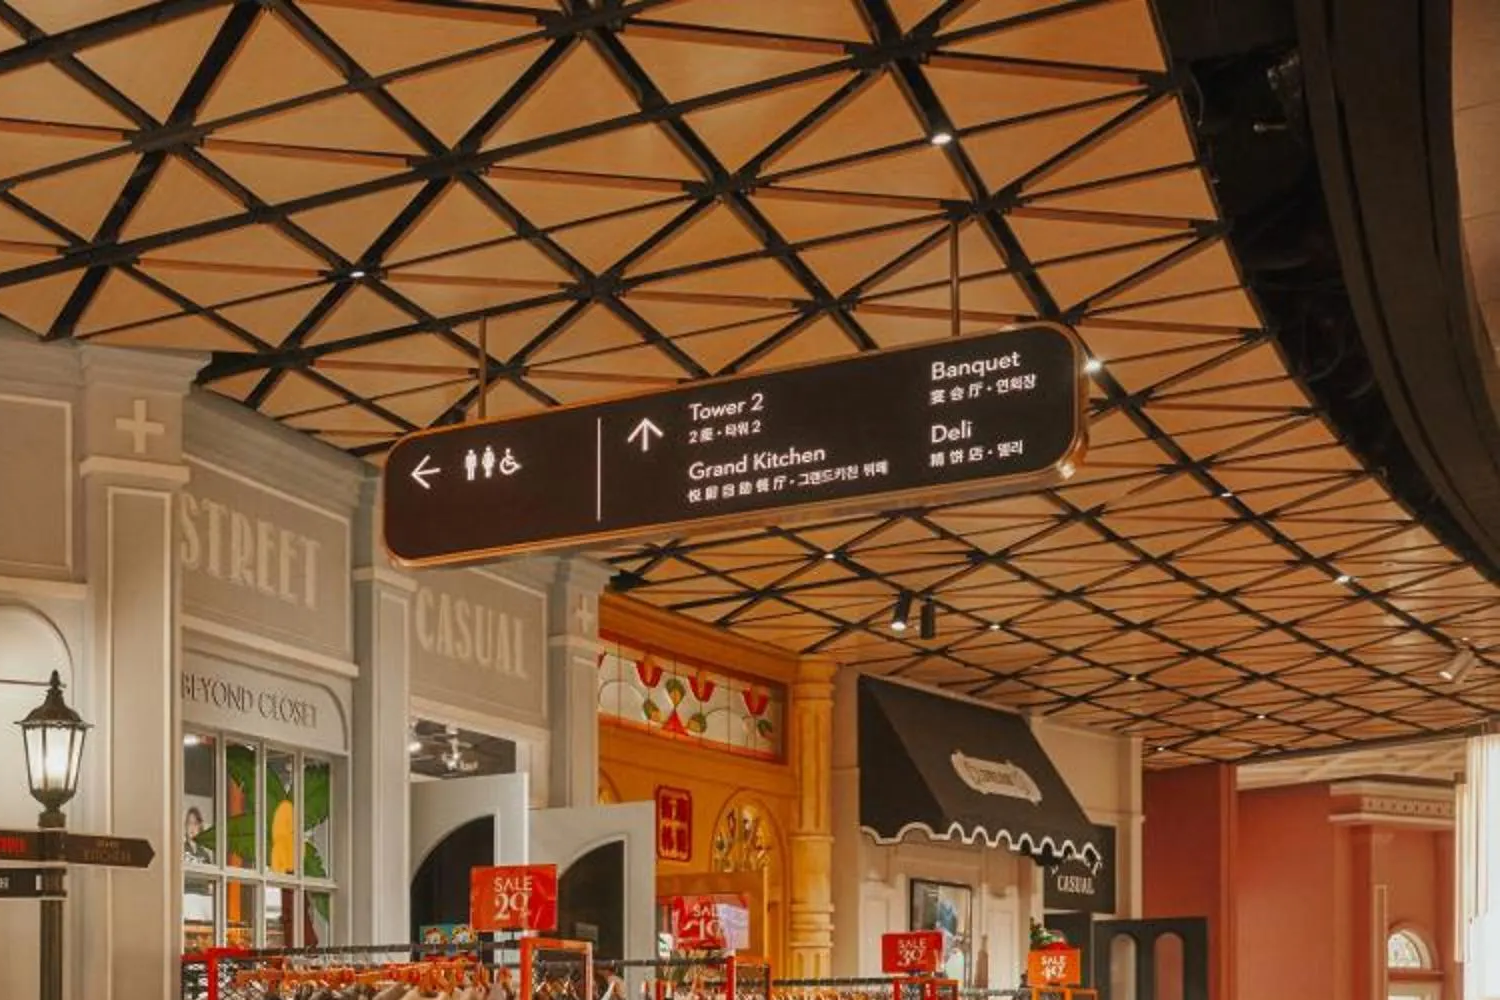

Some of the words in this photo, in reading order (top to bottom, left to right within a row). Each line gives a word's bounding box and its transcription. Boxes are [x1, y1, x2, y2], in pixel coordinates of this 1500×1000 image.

[931, 352, 1021, 382] Banquet
[688, 400, 747, 422] Tower
[751, 392, 764, 411] 2
[931, 419, 974, 444] Deli
[688, 453, 748, 481] Grand
[753, 447, 826, 471] Kitchen
[180, 493, 321, 610] STREET
[416, 586, 527, 680] CASUAL
[181, 671, 254, 714] BEYOND
[258, 690, 318, 729] CLOSET
[494, 875, 533, 892] SALE
[1057, 874, 1095, 895] CASUAL
[693, 901, 719, 917] SAL
